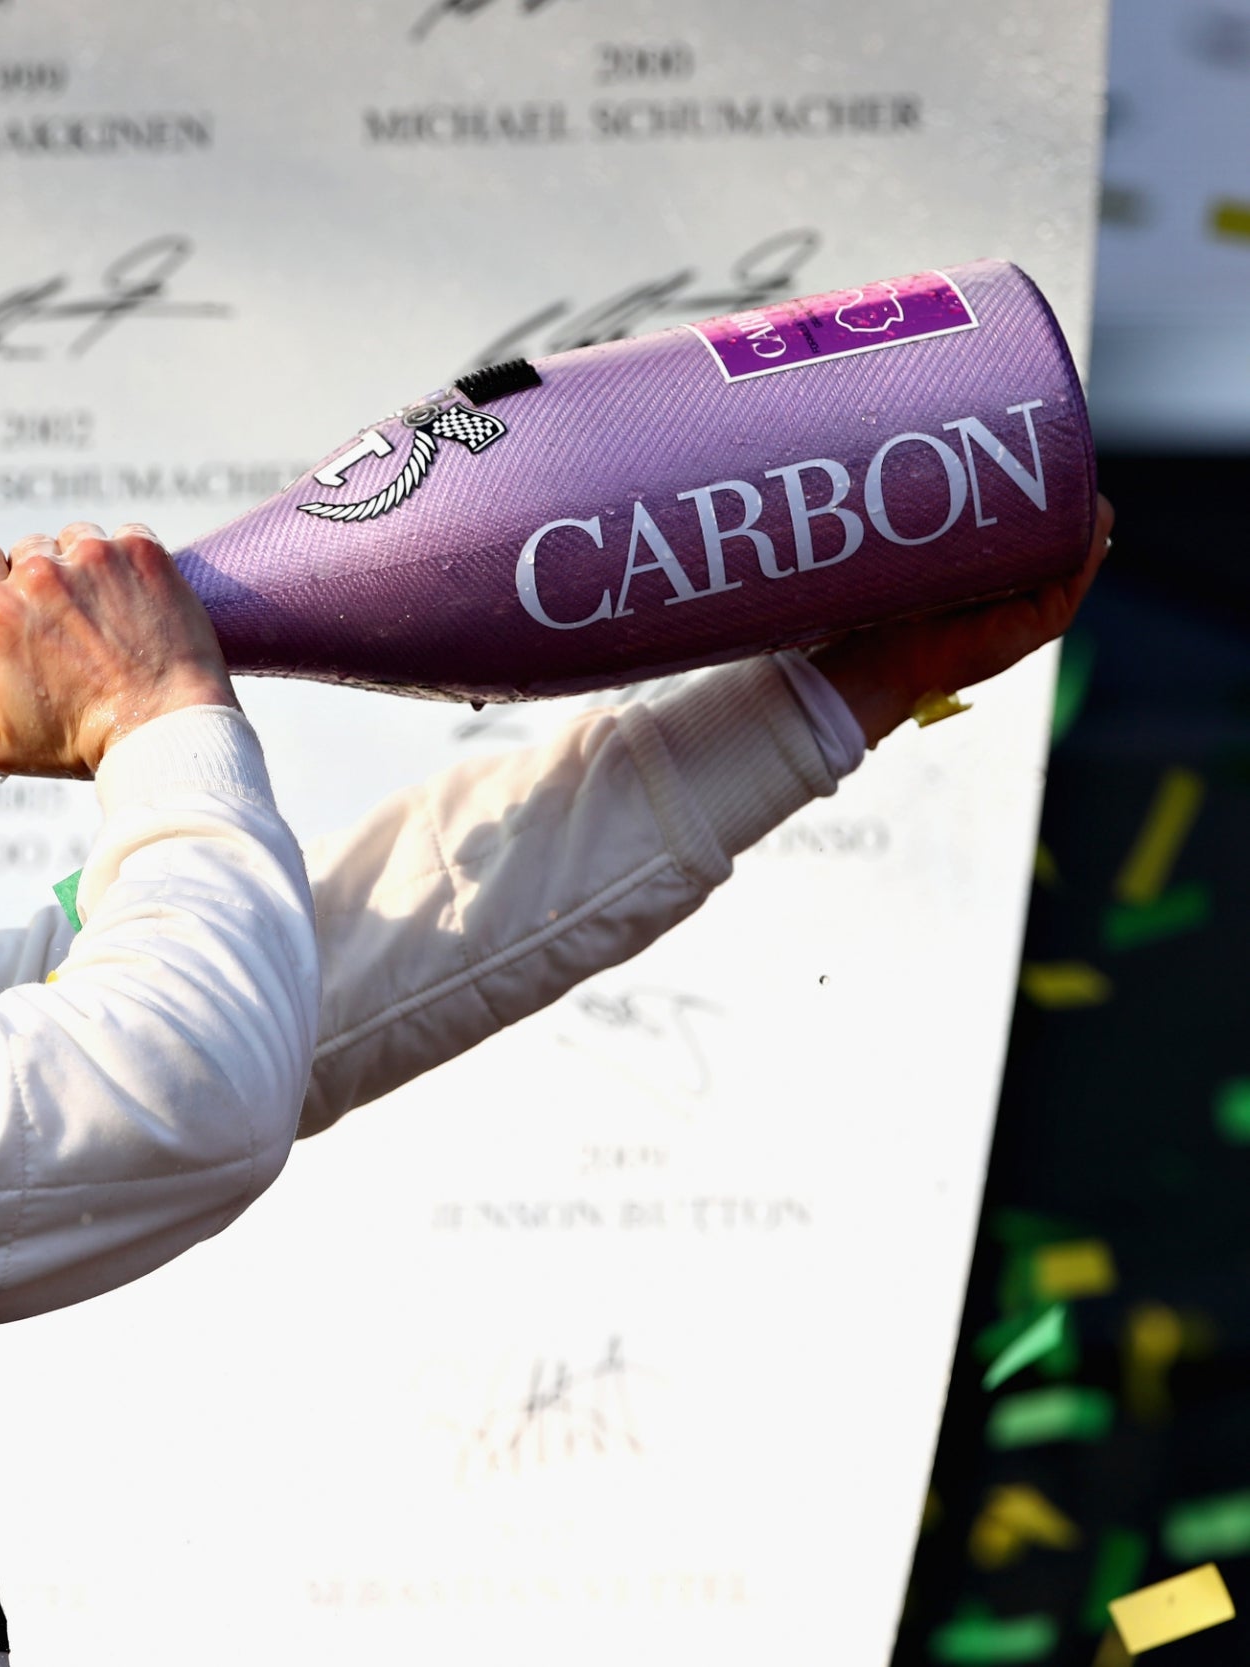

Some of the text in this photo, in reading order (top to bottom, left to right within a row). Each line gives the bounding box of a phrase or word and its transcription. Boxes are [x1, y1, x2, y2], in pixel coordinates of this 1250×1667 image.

[593, 42, 694, 84] 2000
[362, 92, 922, 147] MICHAEL SCHUMACHER
[514, 399, 1048, 631] CARBON
